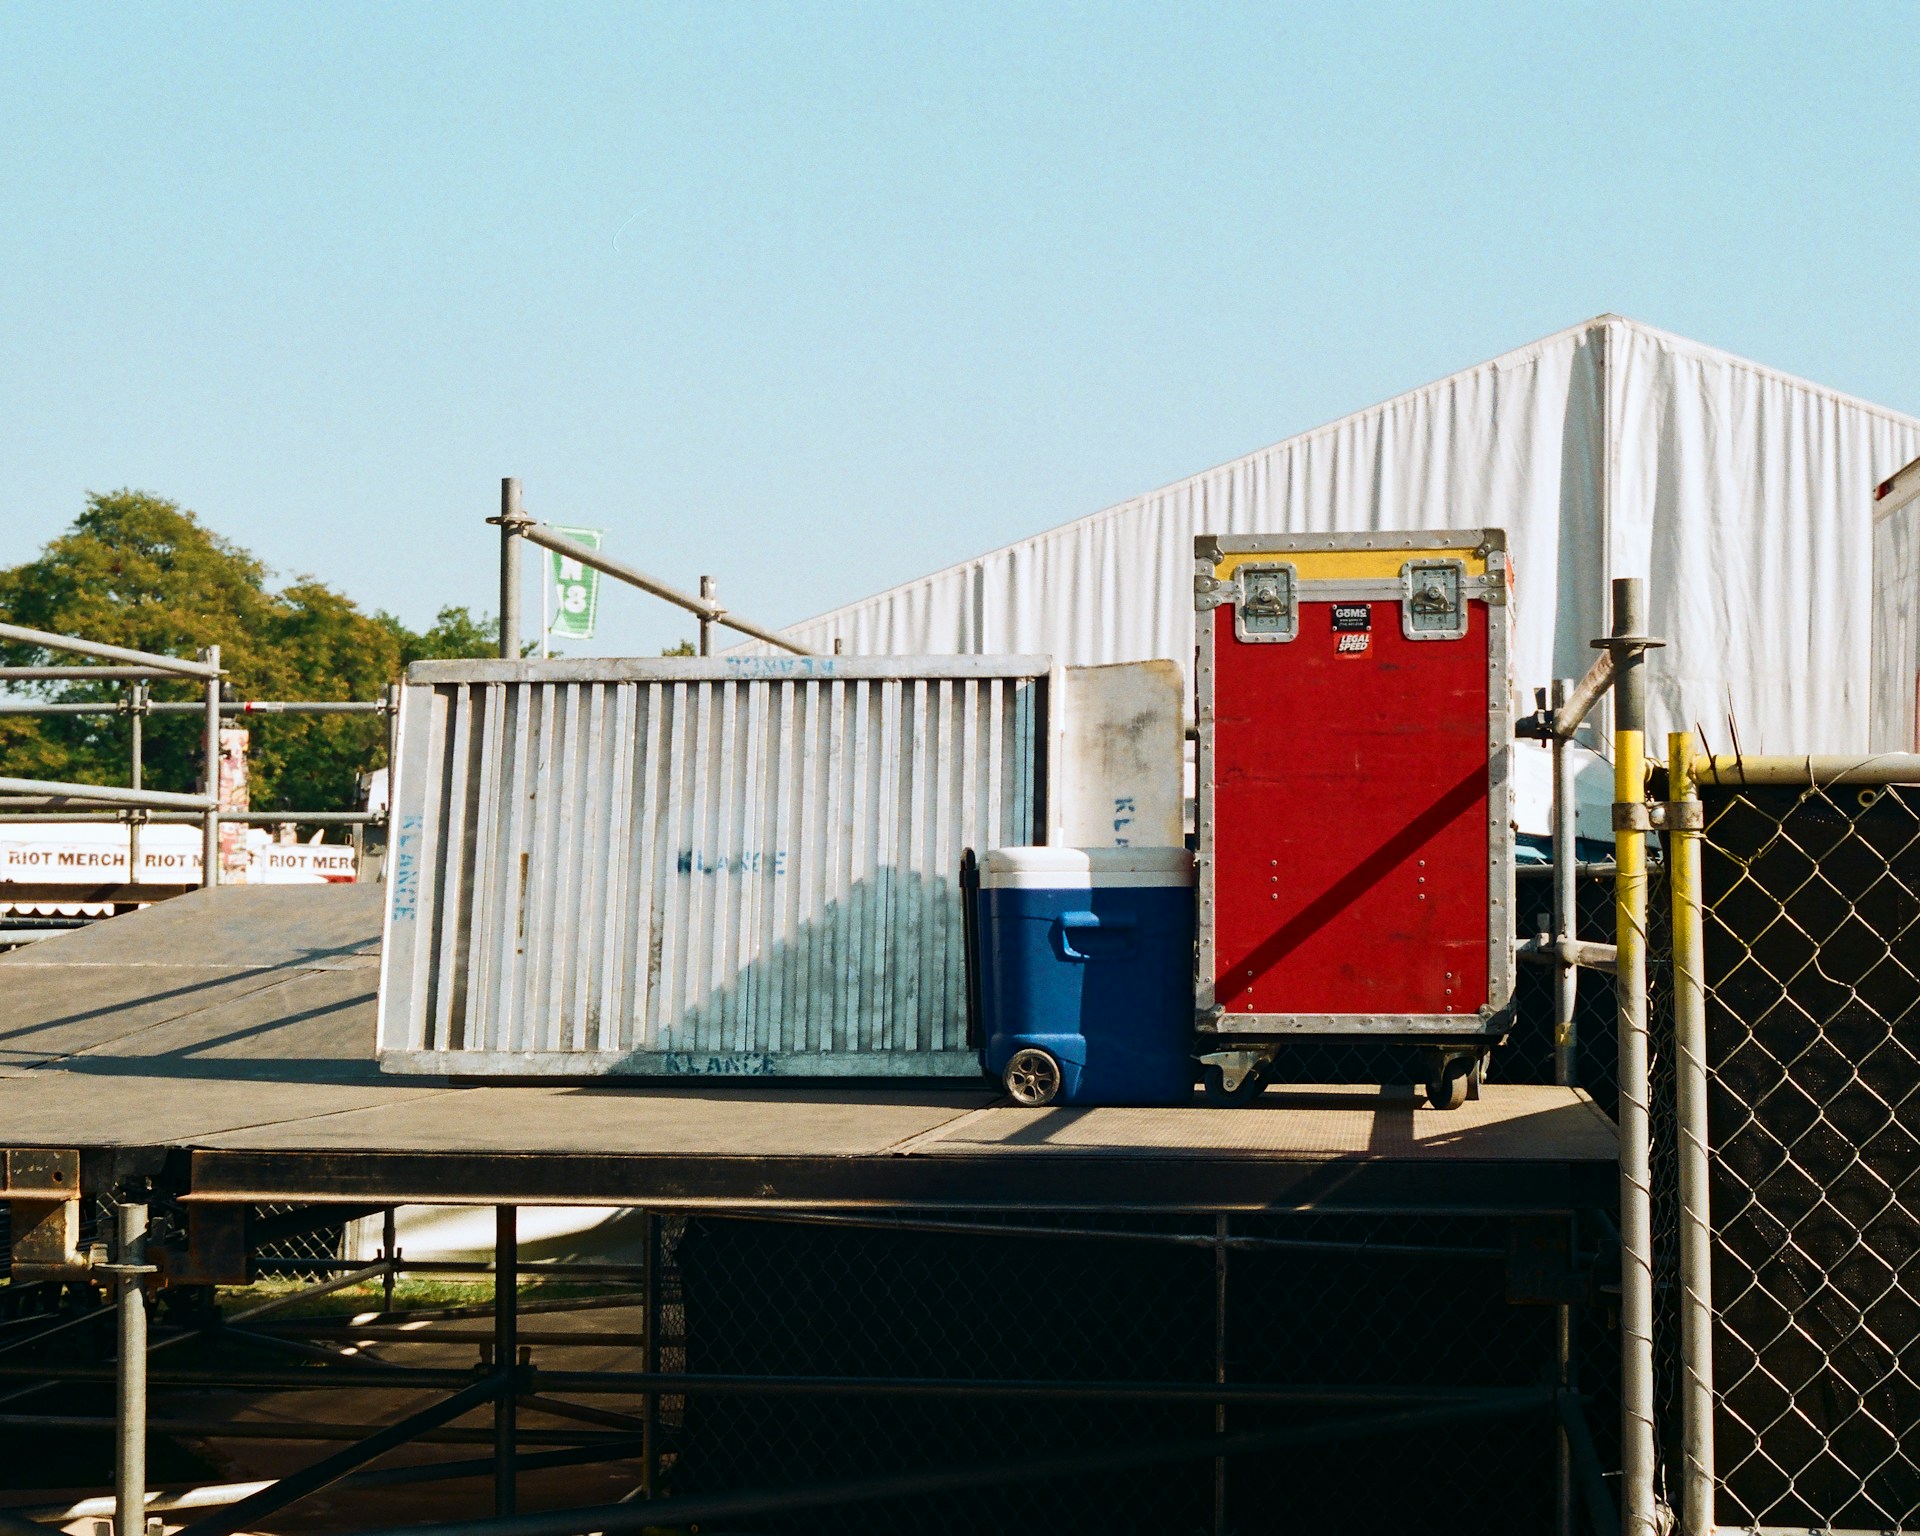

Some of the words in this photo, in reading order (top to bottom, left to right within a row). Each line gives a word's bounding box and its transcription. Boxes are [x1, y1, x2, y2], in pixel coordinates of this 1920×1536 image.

[565, 584, 587, 614] 8
[1340, 634, 1370, 643] LEGAL
[1338, 642, 1368, 652] SPEED
[8, 851, 52, 865] RIOT
[58, 852, 125, 866] MERCH
[145, 854, 186, 867] RIOT
[269, 854, 307, 868] RIOT
[393, 815, 423, 921] KLANCE
[665, 1052, 778, 1074] KLANCE
